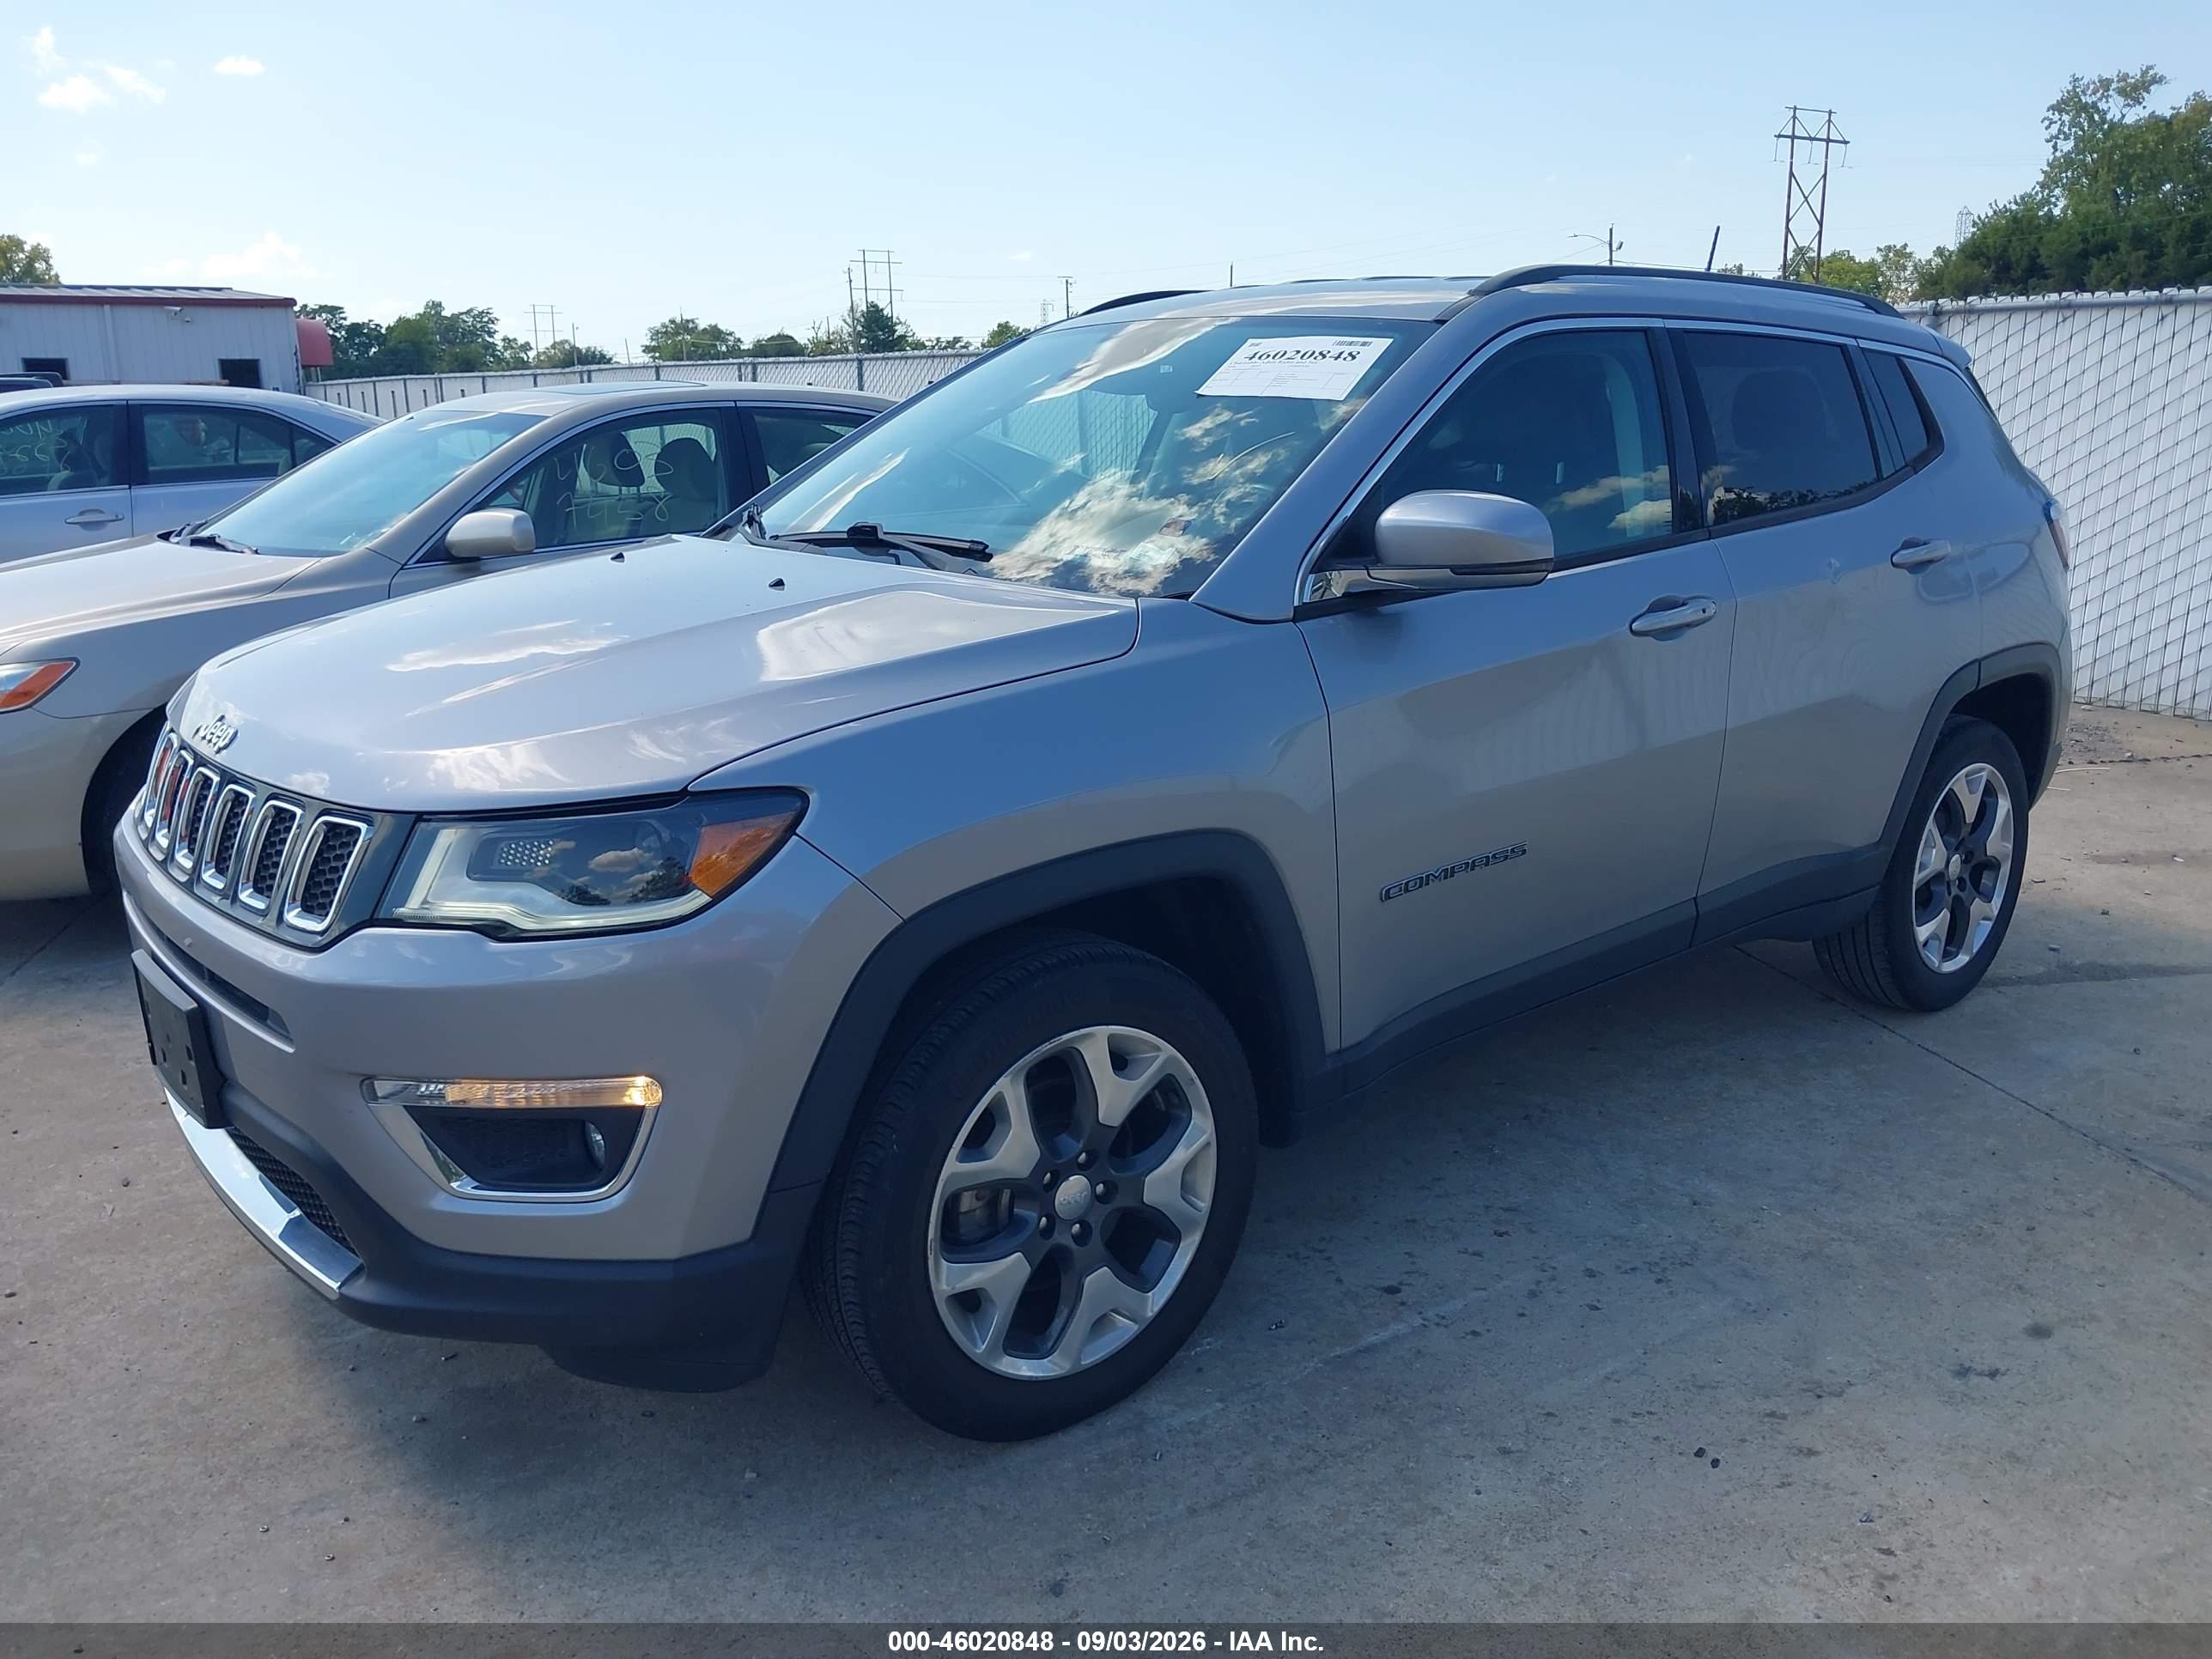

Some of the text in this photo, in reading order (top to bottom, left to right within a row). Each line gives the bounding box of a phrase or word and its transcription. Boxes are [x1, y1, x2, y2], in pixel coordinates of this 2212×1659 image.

[1244, 349, 1361, 362] 46020848
[192, 714, 239, 755] Jeep
[1379, 840, 1528, 903] COMPASS
